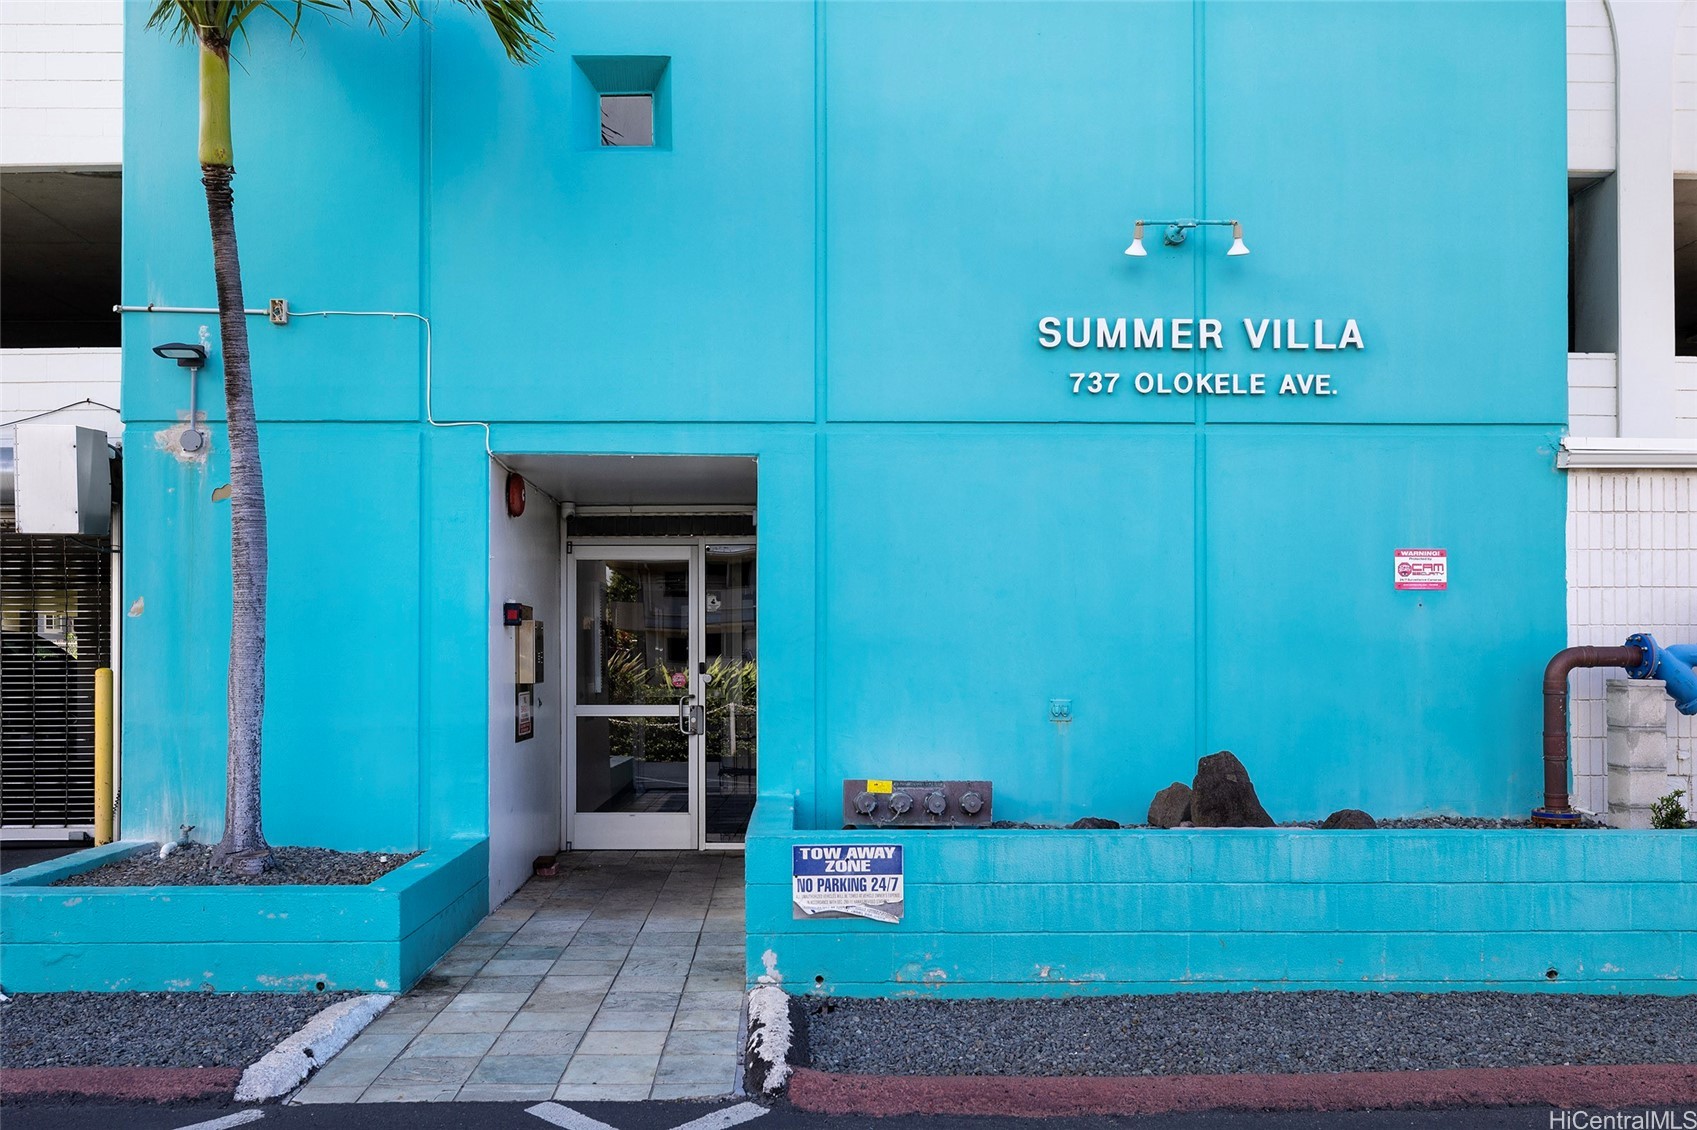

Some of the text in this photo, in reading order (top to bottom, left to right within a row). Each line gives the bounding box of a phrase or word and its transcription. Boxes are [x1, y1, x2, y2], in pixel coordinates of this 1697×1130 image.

[1038, 317, 1365, 350] SUMMER VILLA
[1069, 372, 1338, 395] 737 OLOKELE AVE.
[1412, 563, 1444, 571] CAM
[800, 847, 896, 860] TOW AWAY
[825, 860, 871, 872] ZONE
[797, 877, 899, 893] NO PARKING 24/7
